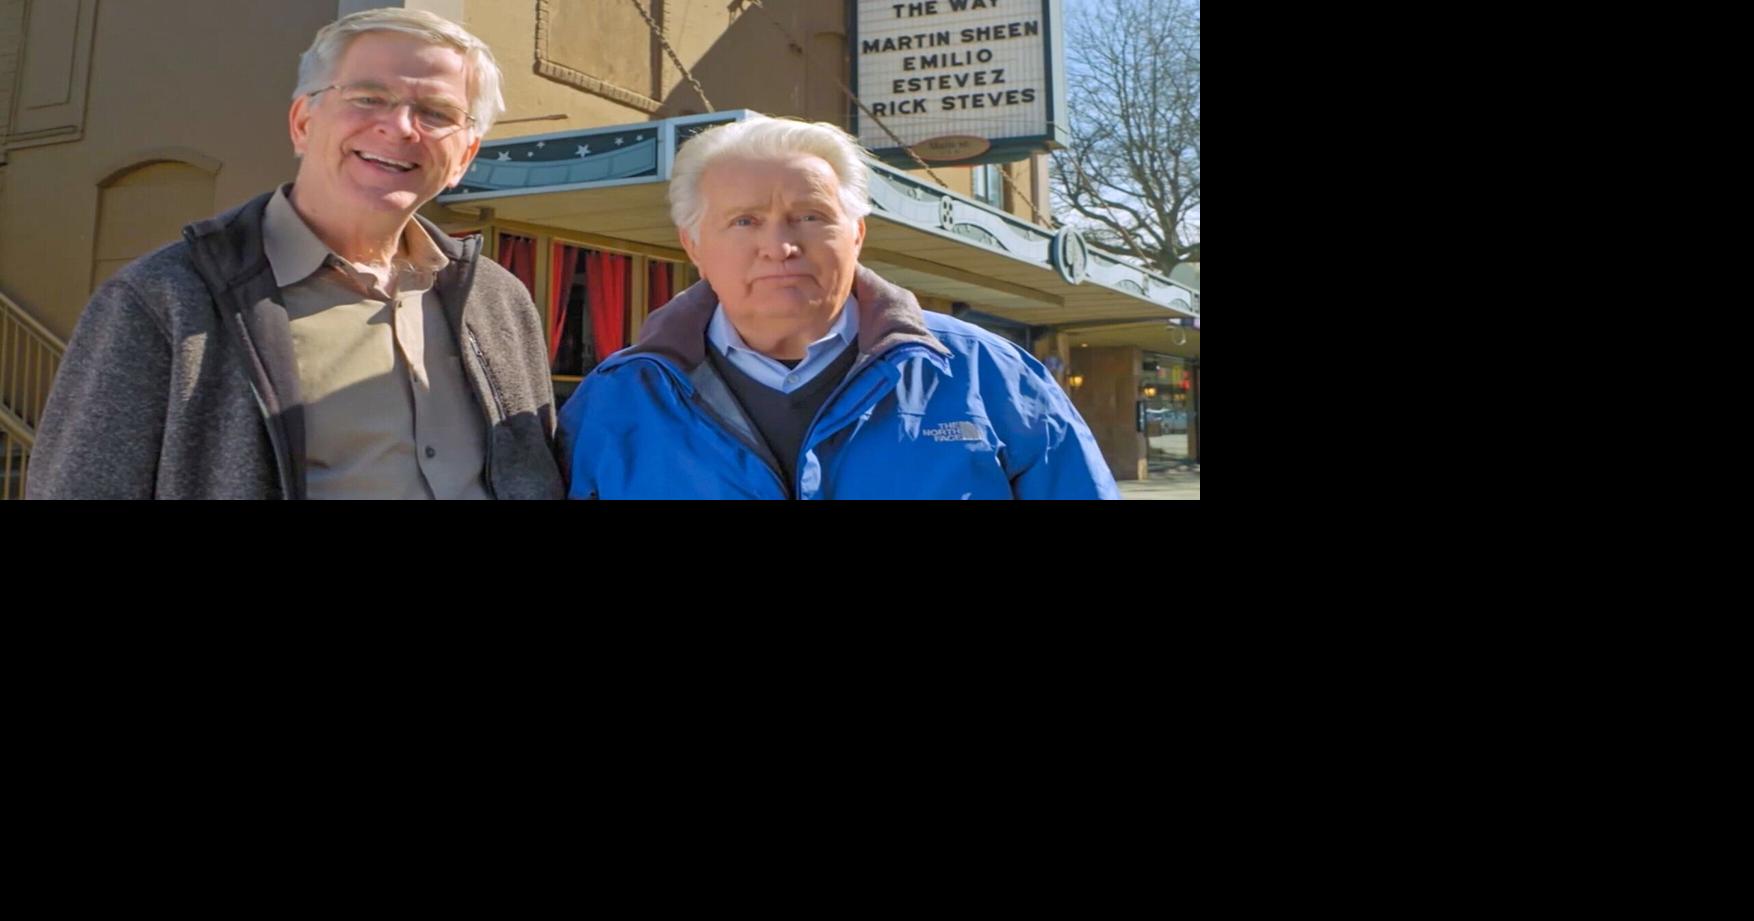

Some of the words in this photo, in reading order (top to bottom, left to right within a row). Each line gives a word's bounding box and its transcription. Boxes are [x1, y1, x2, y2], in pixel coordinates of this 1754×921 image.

[893, 0, 938, 18] THE
[862, 31, 950, 54] MARTIN
[960, 20, 1039, 44] SHEEN
[902, 48, 993, 71] EMILIO
[892, 68, 1006, 94] ESTEVEZ
[872, 98, 927, 117] RICK
[941, 88, 1036, 110] STEVES
